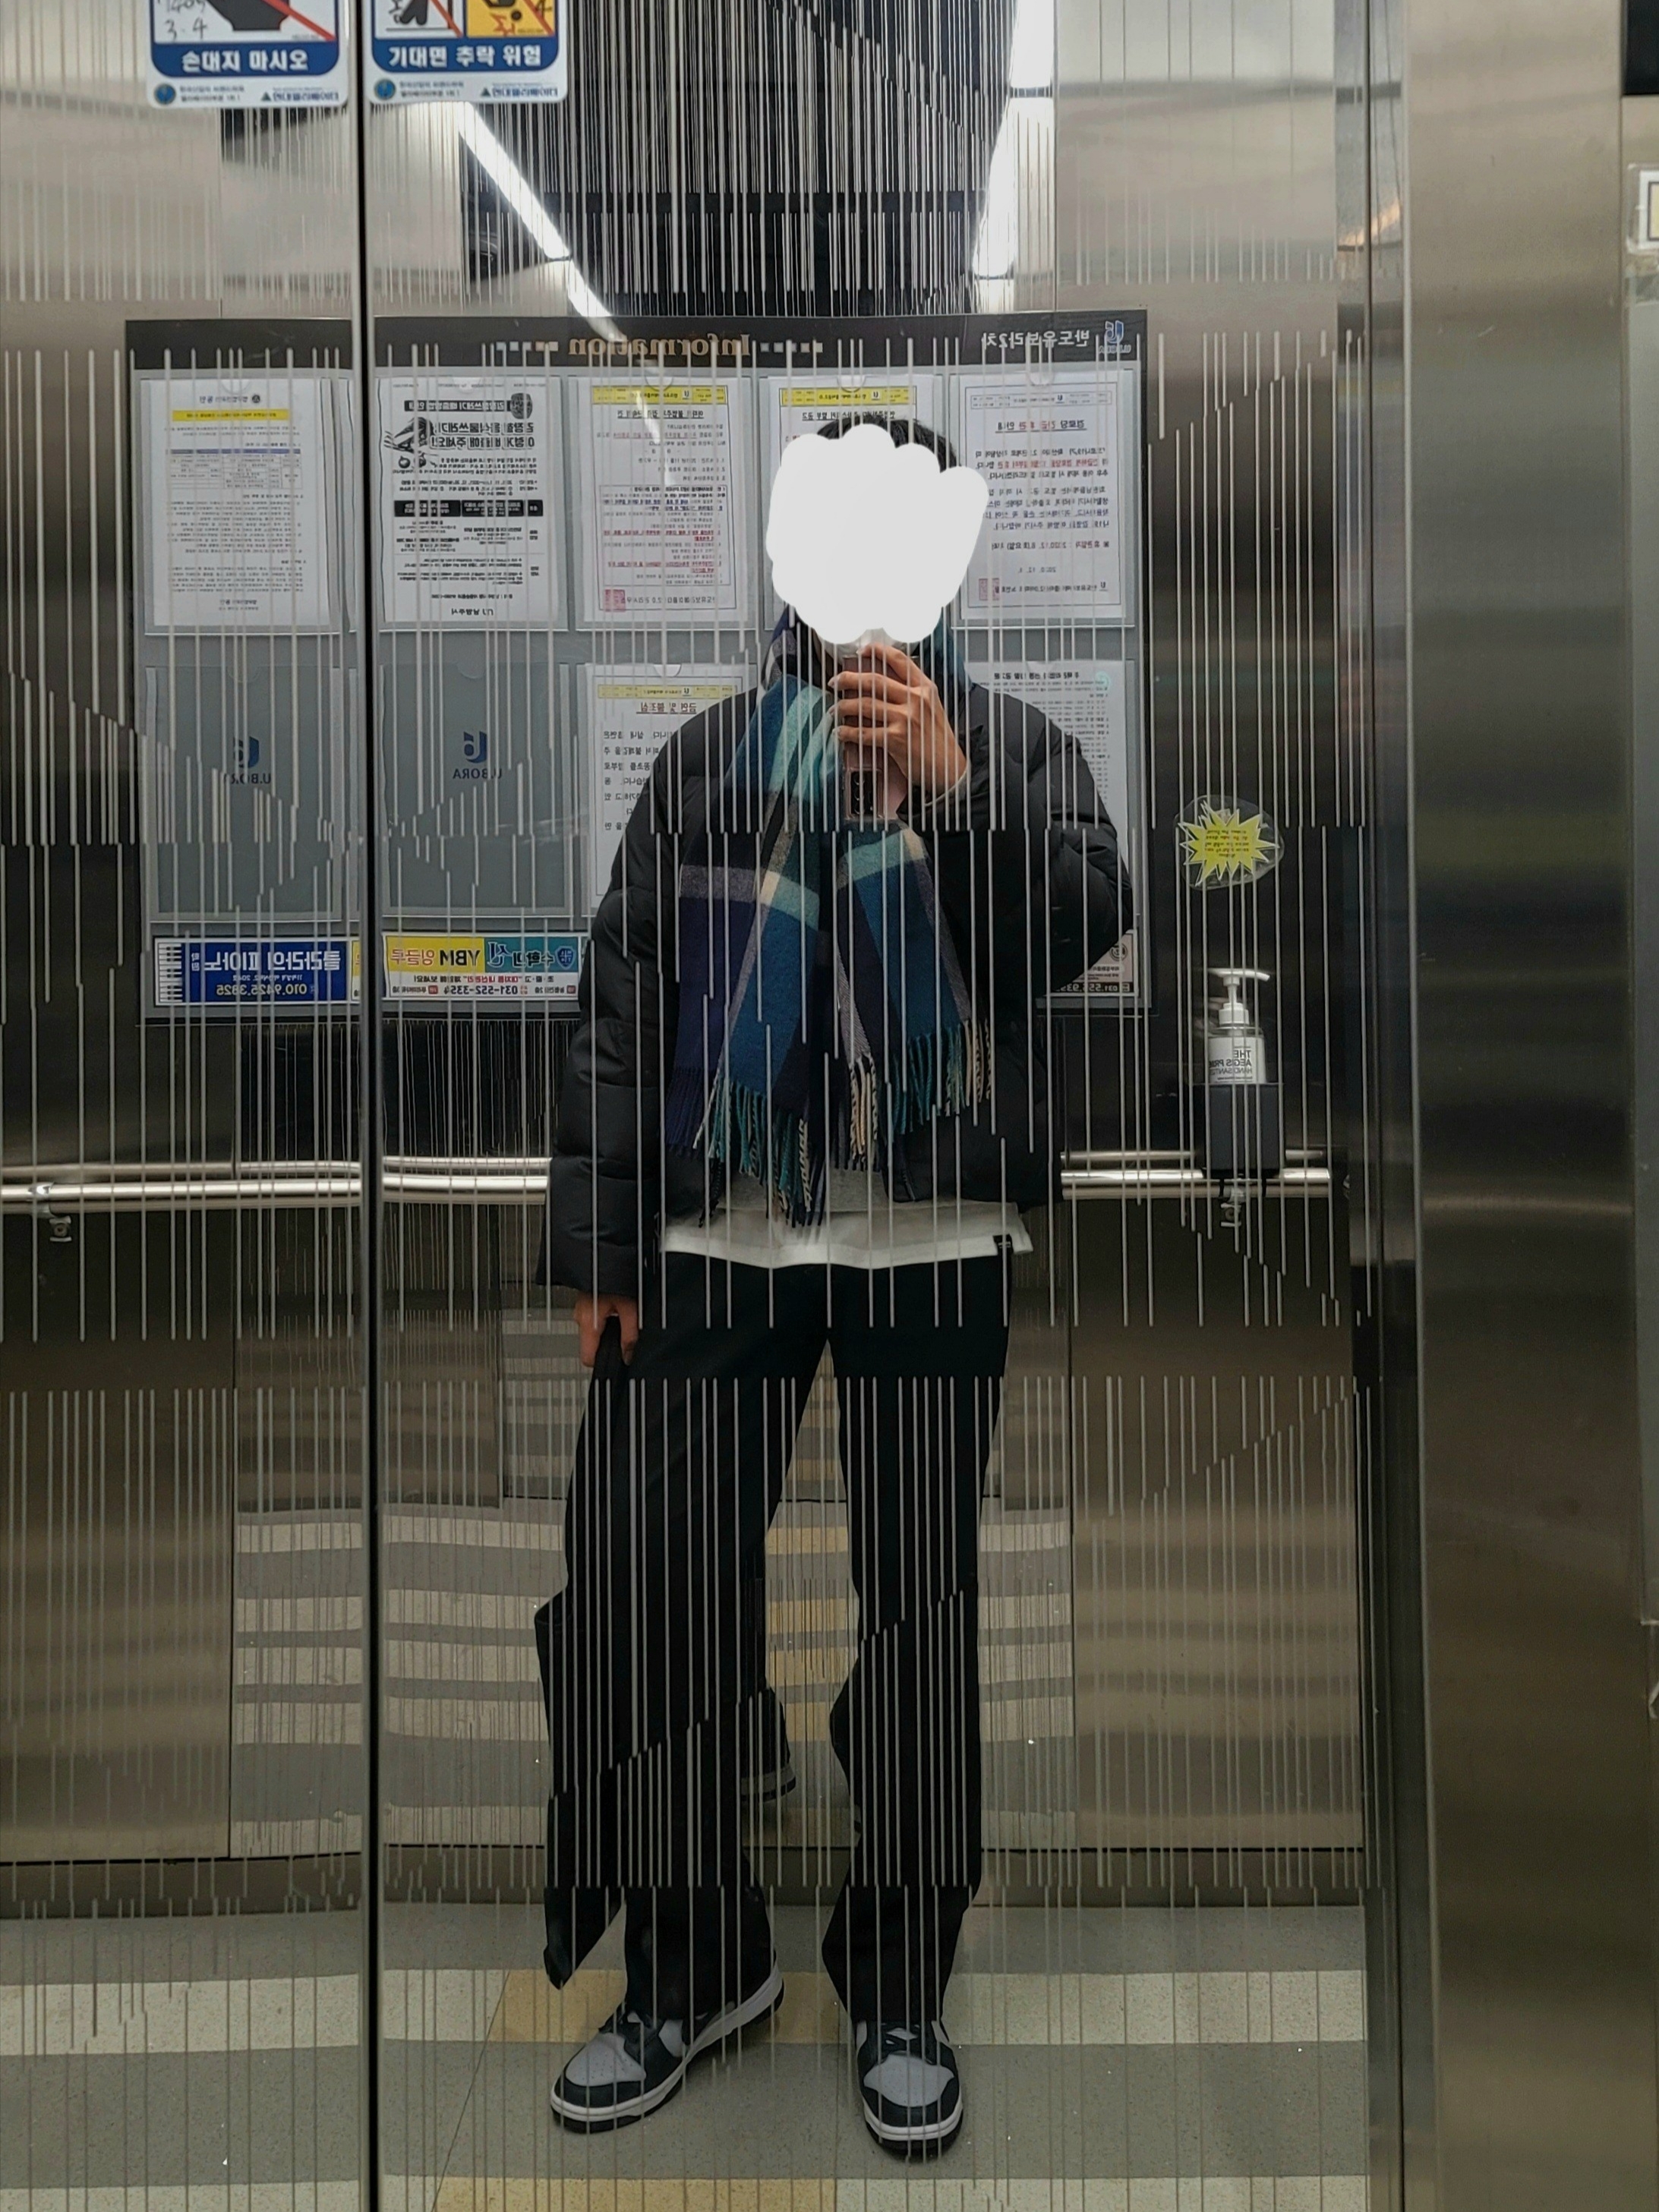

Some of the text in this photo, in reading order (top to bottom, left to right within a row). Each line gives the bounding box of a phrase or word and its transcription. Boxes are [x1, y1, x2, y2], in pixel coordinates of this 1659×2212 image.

[181, 49, 308, 72] 손대지 마시오
[388, 45, 541, 68] 기대면 추락 위험
